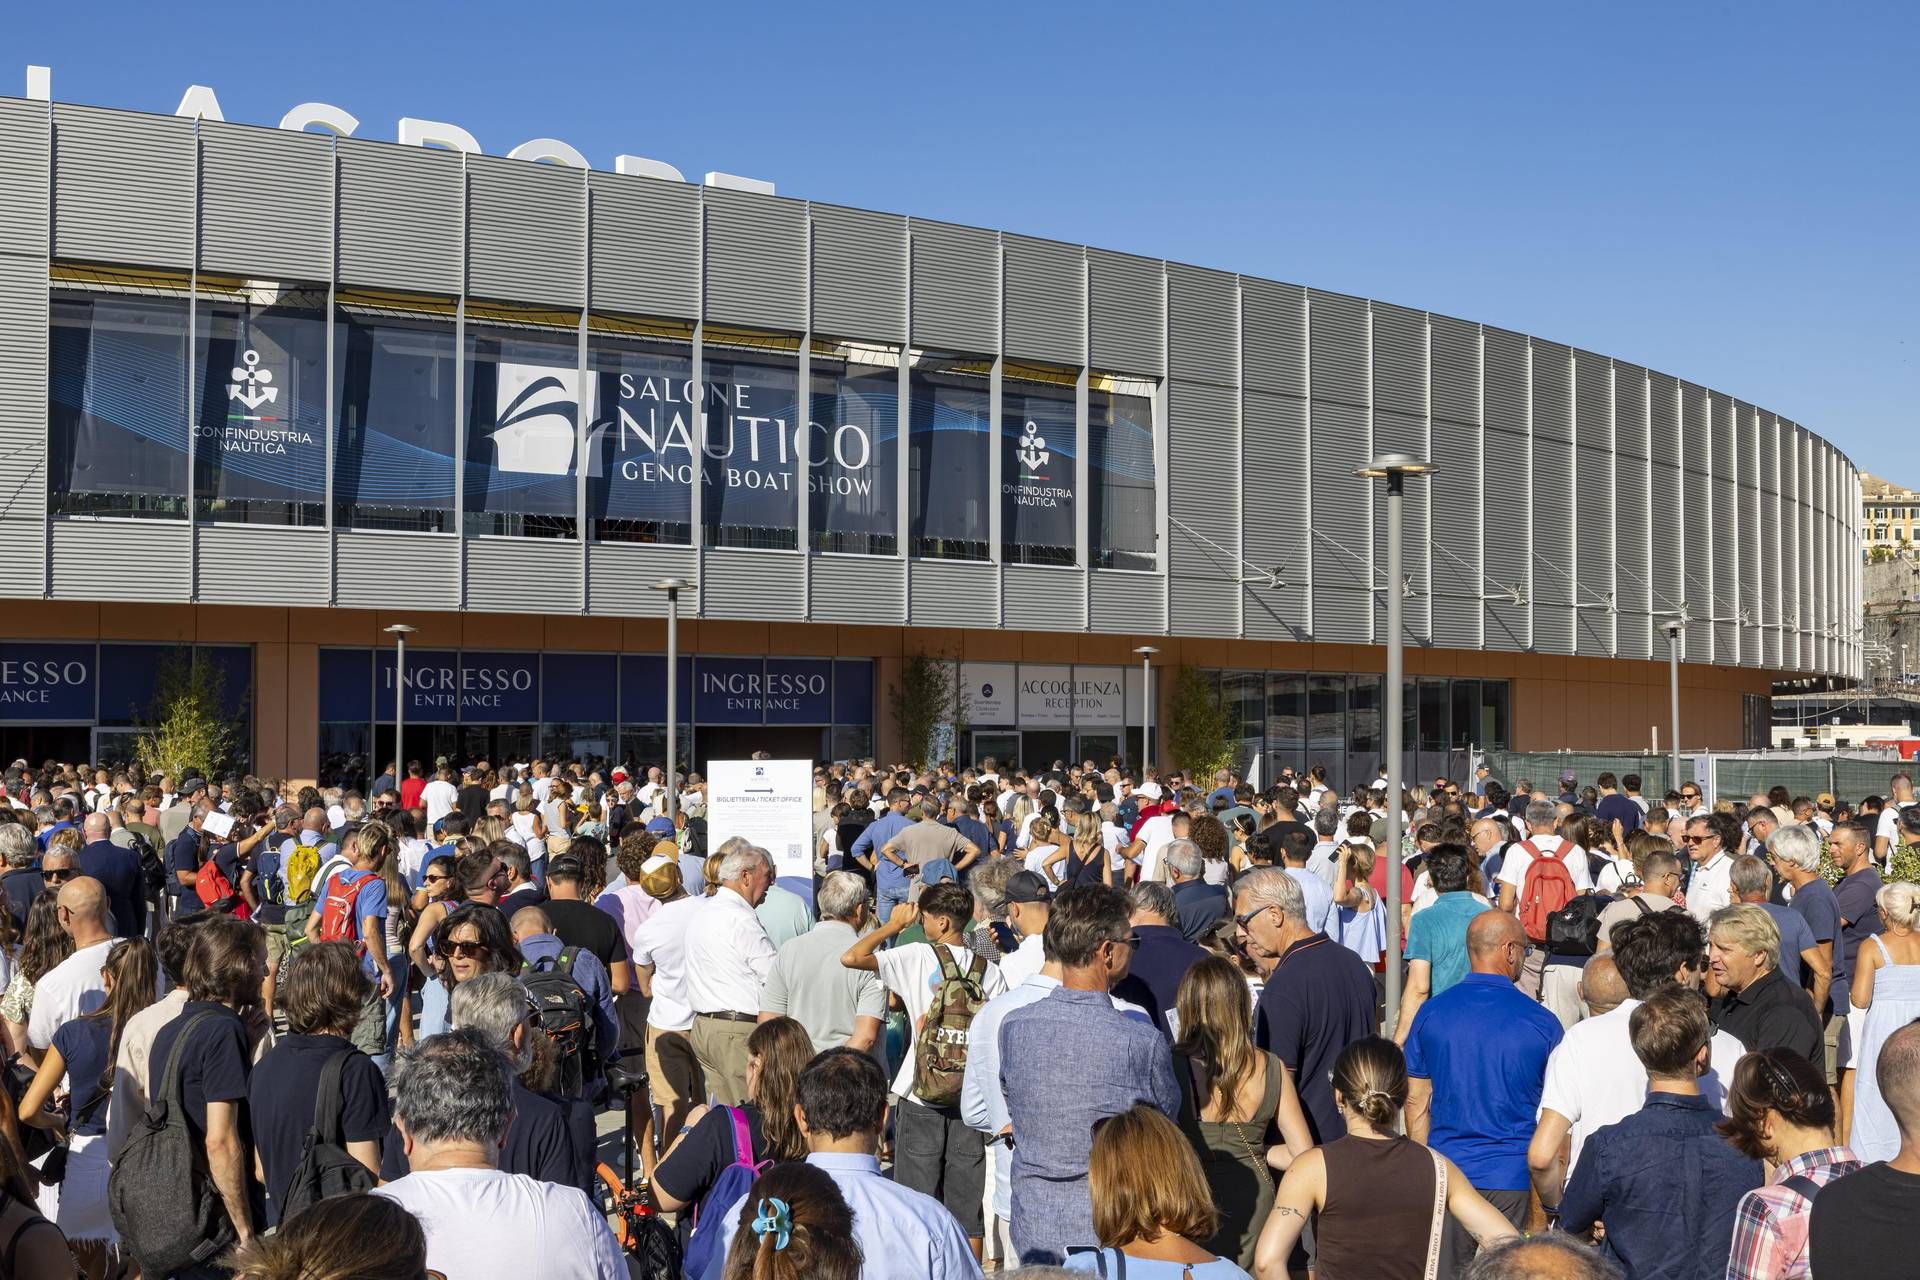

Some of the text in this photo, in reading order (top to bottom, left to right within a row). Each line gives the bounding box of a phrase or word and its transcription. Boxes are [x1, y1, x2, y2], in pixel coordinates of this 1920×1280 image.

[620, 374, 750, 409] SALONE
[193, 426, 312, 444] CONFINDUSTRIA
[616, 406, 870, 470] NAUTICO
[221, 441, 286, 455] NAUTICA
[622, 461, 871, 496] GENOA BOAT SHOW
[1001, 484, 1072, 498] ONFINDUSTRIA
[1014, 495, 1056, 507] NAUTICA
[385, 667, 531, 691] INGRESSO
[704, 673, 825, 695] INGRESSO
[1021, 680, 1121, 695] ACCOGLIENZA
[415, 694, 501, 706] ENTRANCE
[728, 698, 800, 710] ENTRANCE
[1045, 698, 1103, 709] RECEPTION
